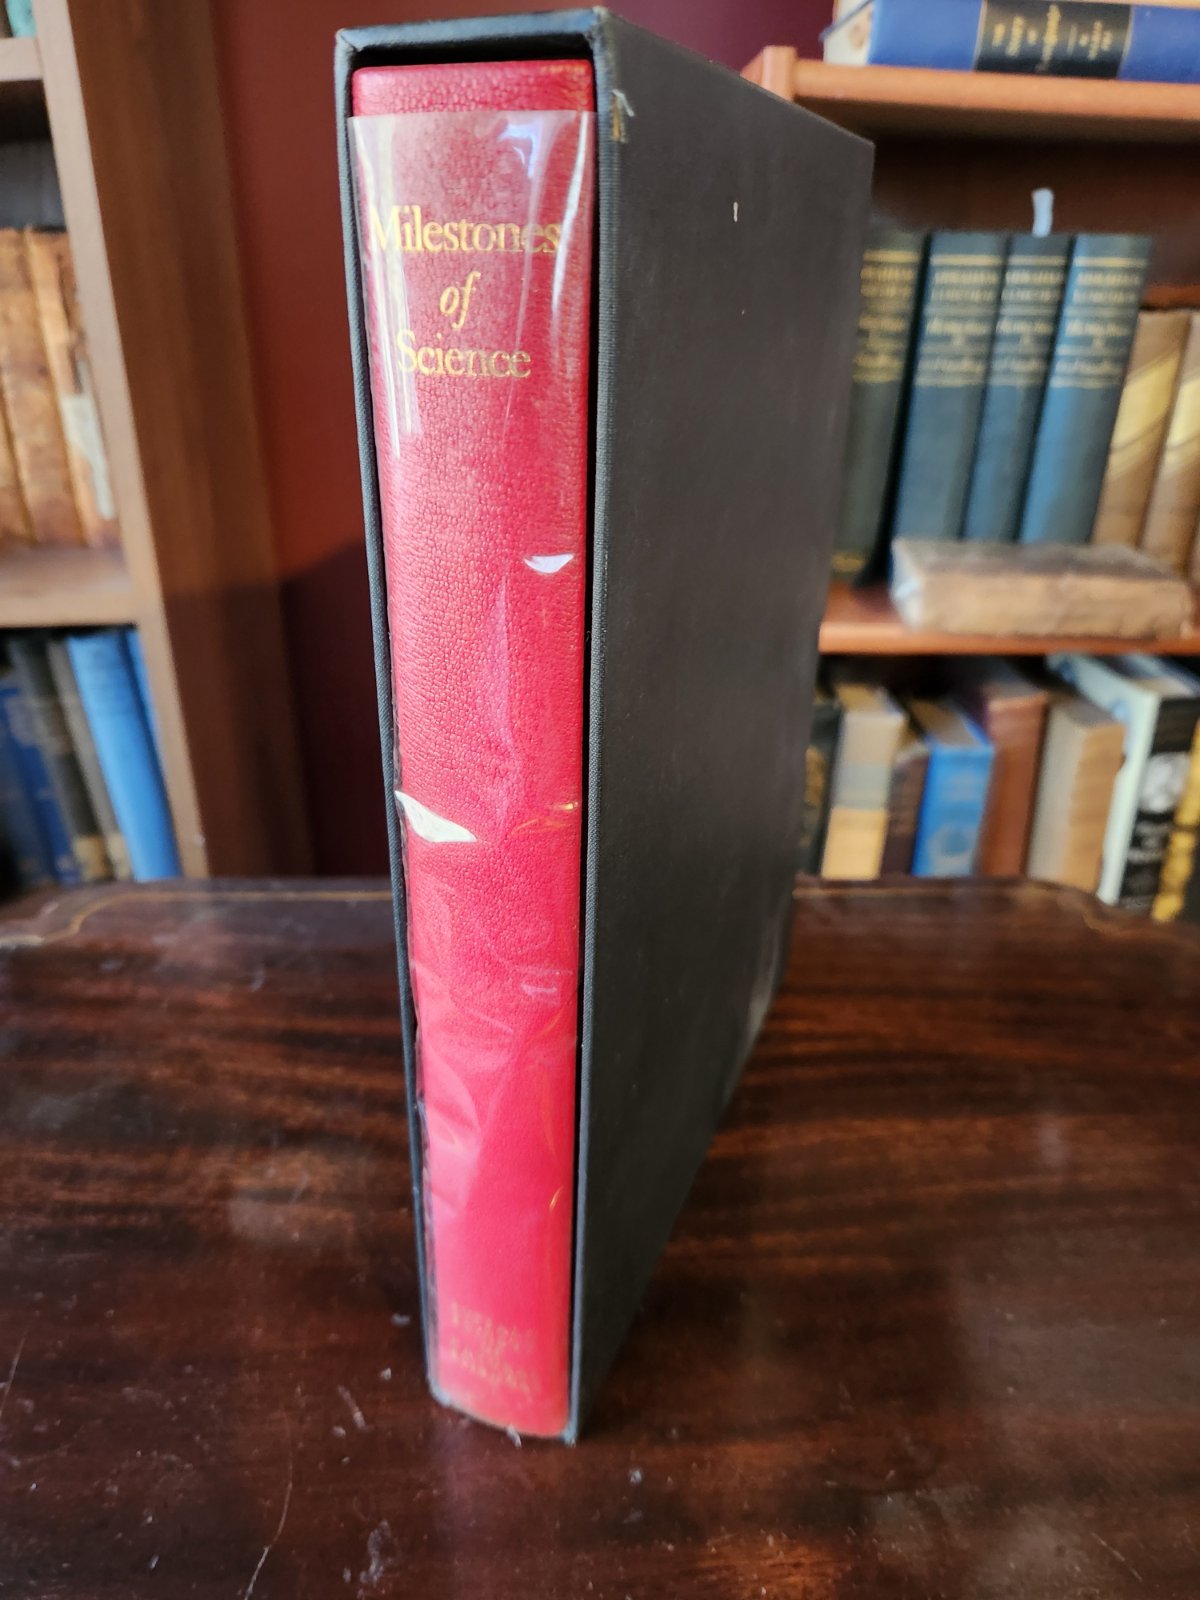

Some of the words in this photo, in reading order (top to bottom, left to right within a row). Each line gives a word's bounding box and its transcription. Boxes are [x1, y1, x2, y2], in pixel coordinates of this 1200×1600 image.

[371, 205, 563, 252] Milestones
[439, 271, 481, 331] of
[396, 330, 531, 377] Science
